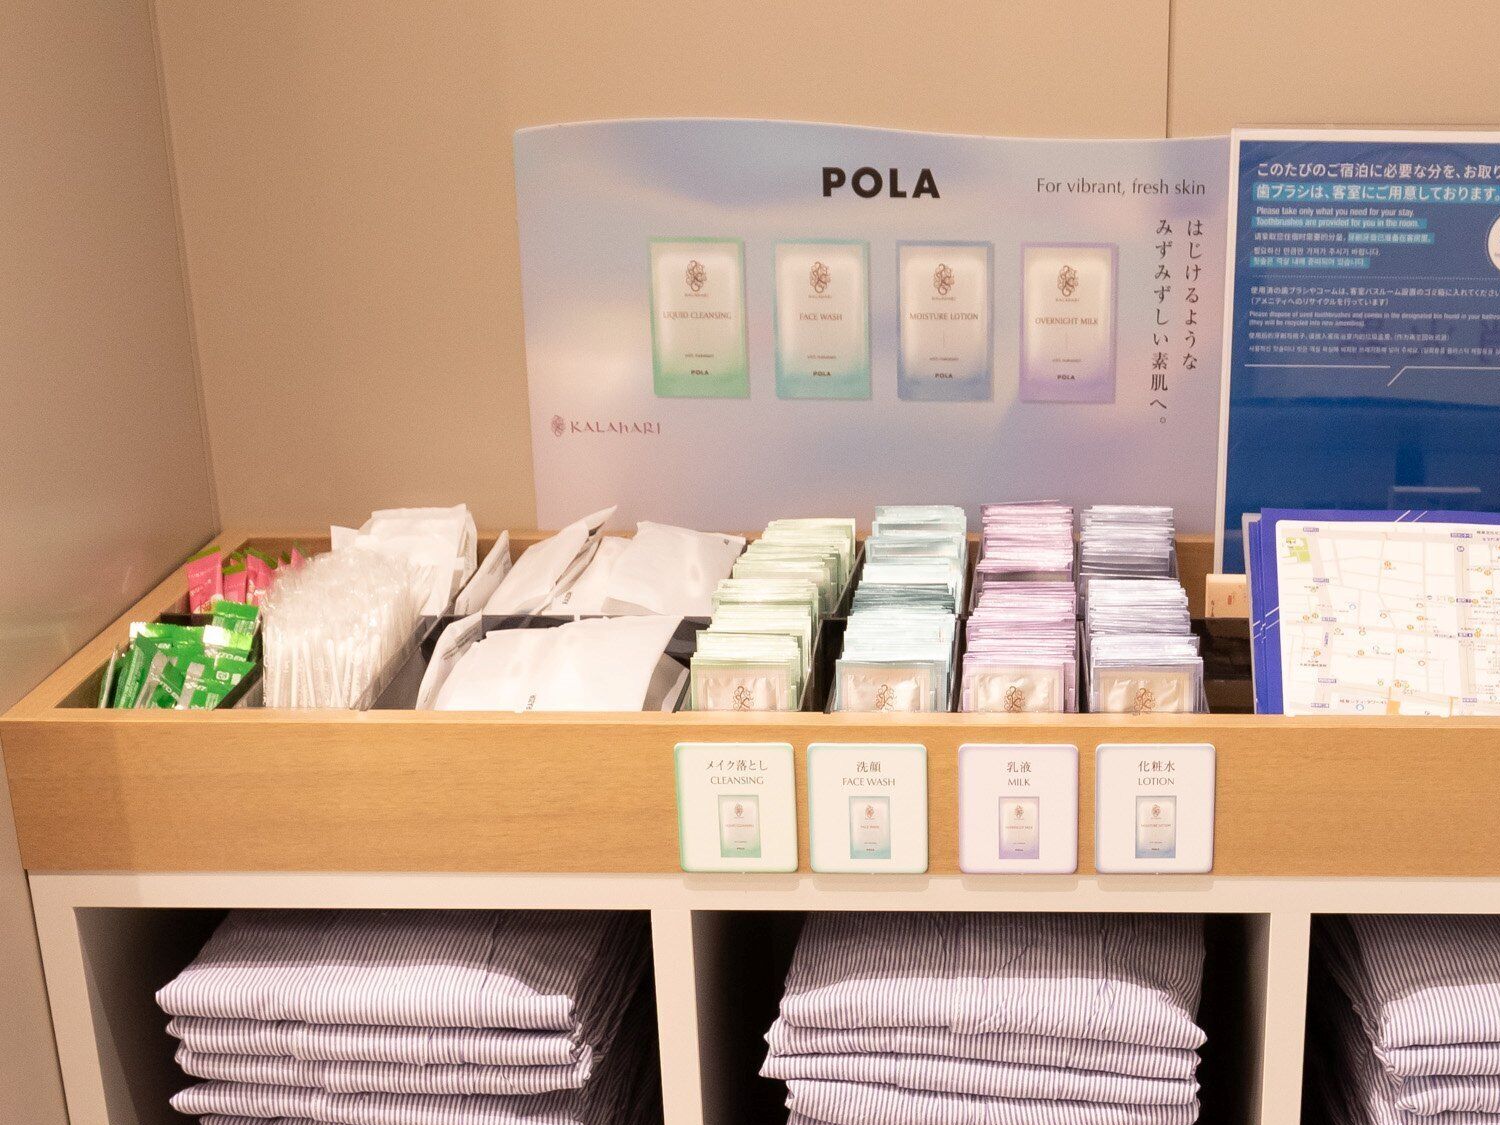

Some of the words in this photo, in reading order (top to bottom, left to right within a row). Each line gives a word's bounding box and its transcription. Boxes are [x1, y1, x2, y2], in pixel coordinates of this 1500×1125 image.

[822, 166, 941, 199] POLA
[1037, 178, 1060, 193] For
[1066, 178, 1126, 196] vibrant,
[1132, 178, 1168, 194] fresh
[1175, 179, 1206, 195] skin
[1256, 206, 1280, 215] Please
[1299, 207, 1314, 217] only
[1316, 207, 1333, 215] what
[1335, 209, 1348, 217] you
[1350, 207, 1367, 216] need
[1381, 209, 1396, 218] your
[1182, 219, 1203, 371] はじけるような
[820, 312, 843, 321] WASH
[909, 312, 948, 321] MOISTURE
[950, 312, 979, 320] LOTION
[1035, 317, 1078, 326] OVERNIGHT
[1080, 317, 1098, 326] MILK
[1150, 219, 1173, 424] みずみずしい素肌へ。
[706, 760, 769, 771] メイク落とし
[856, 761, 882, 773] 洗顔
[1006, 761, 1032, 773] 乳液
[1137, 760, 1176, 772] 化粧水
[710, 776, 764, 785] CLEANSING
[842, 778, 866, 786] FACE
[866, 777, 896, 786] WASH
[1007, 778, 1031, 786] MILK
[1138, 777, 1175, 786] LOTION
